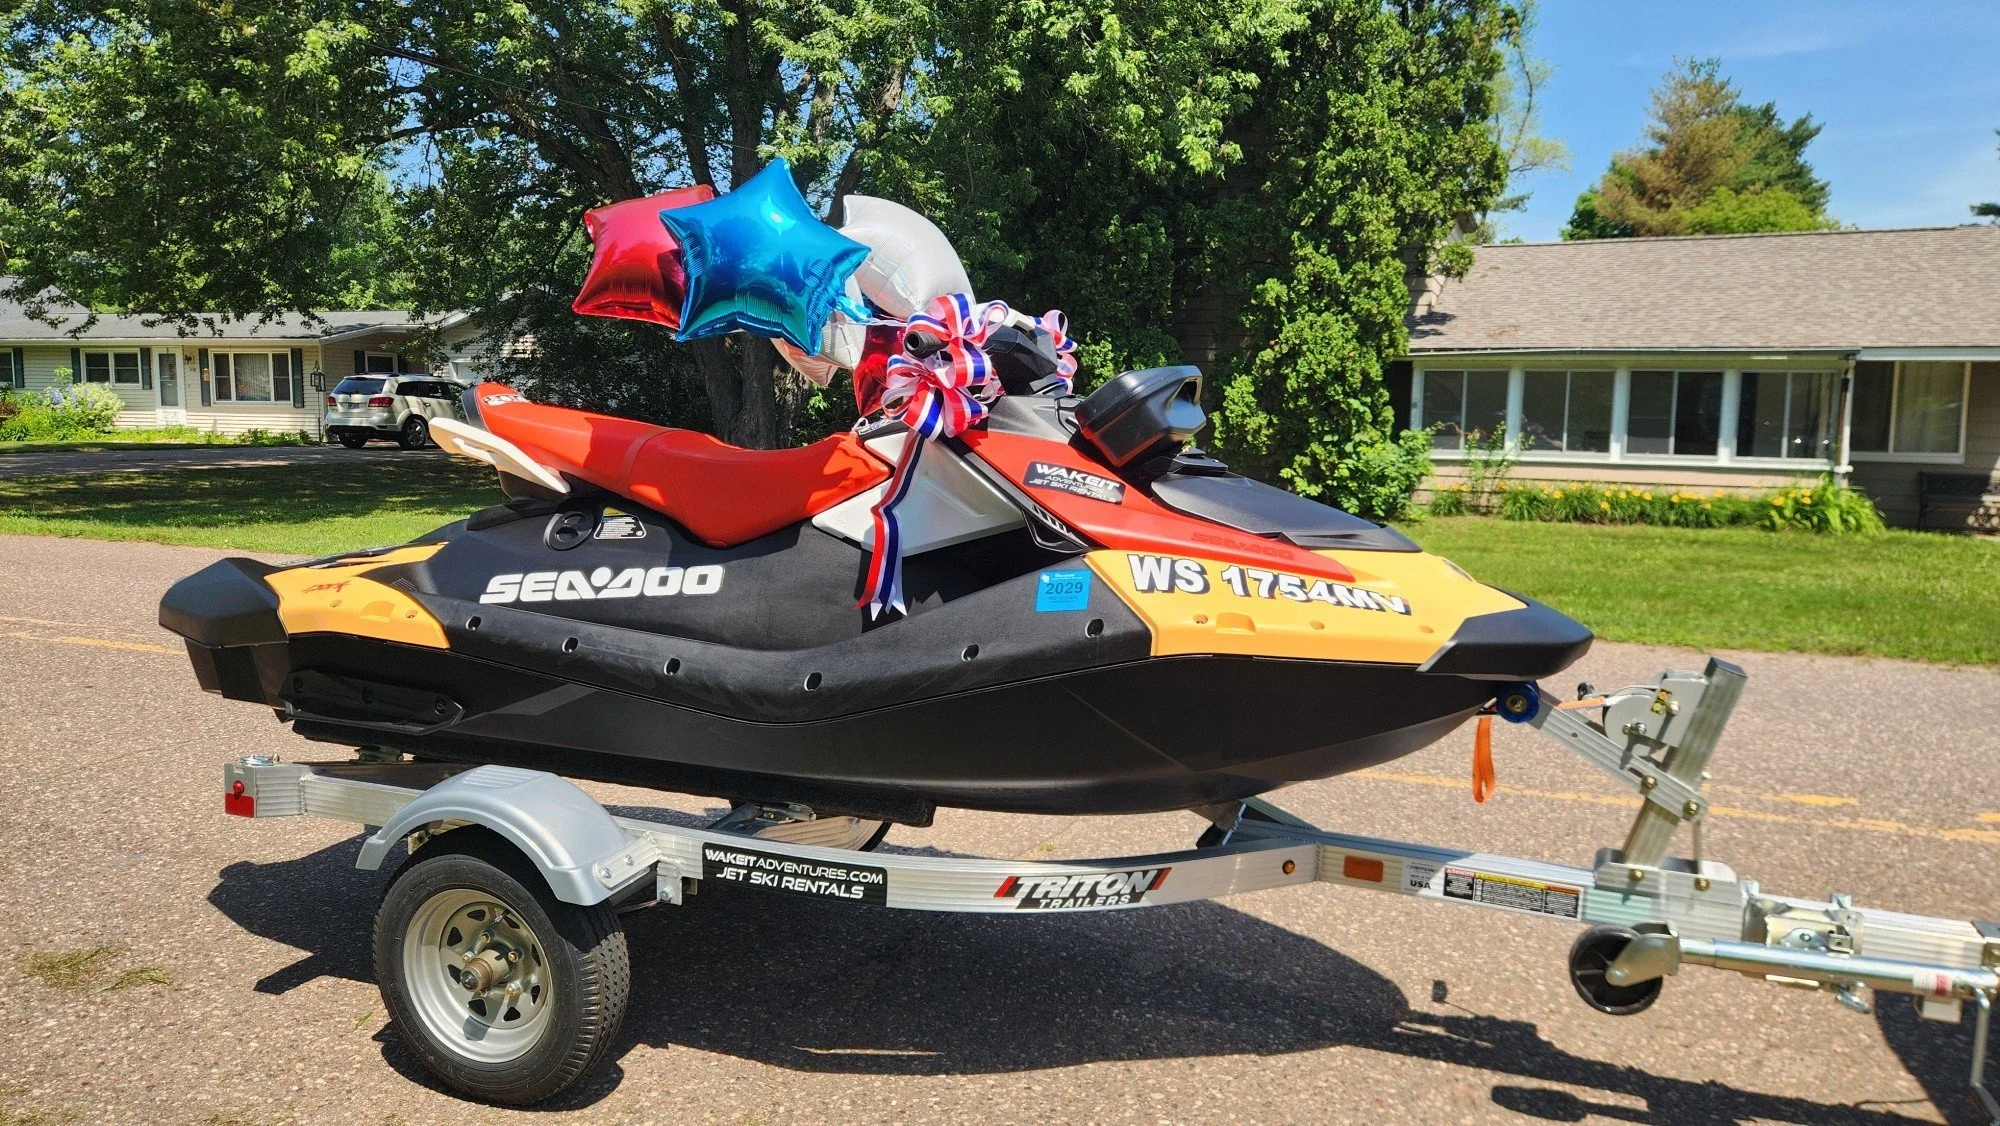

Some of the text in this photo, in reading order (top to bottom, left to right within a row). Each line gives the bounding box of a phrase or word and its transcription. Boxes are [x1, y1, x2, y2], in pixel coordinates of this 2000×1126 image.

[1036, 463, 1119, 490] WAKEIT
[1050, 481, 1068, 489] SKI
[1069, 485, 1116, 503] RENTALS
[1128, 554, 1210, 594] WS
[1045, 582, 1083, 595] 2029
[705, 849, 883, 884] WAKEITADVENTURES.COM
[716, 867, 864, 899] JET SKI RENTALS
[1014, 869, 1158, 899] TRITON
[1410, 879, 1431, 889] USA
[1039, 895, 1131, 909] TRAILERS
